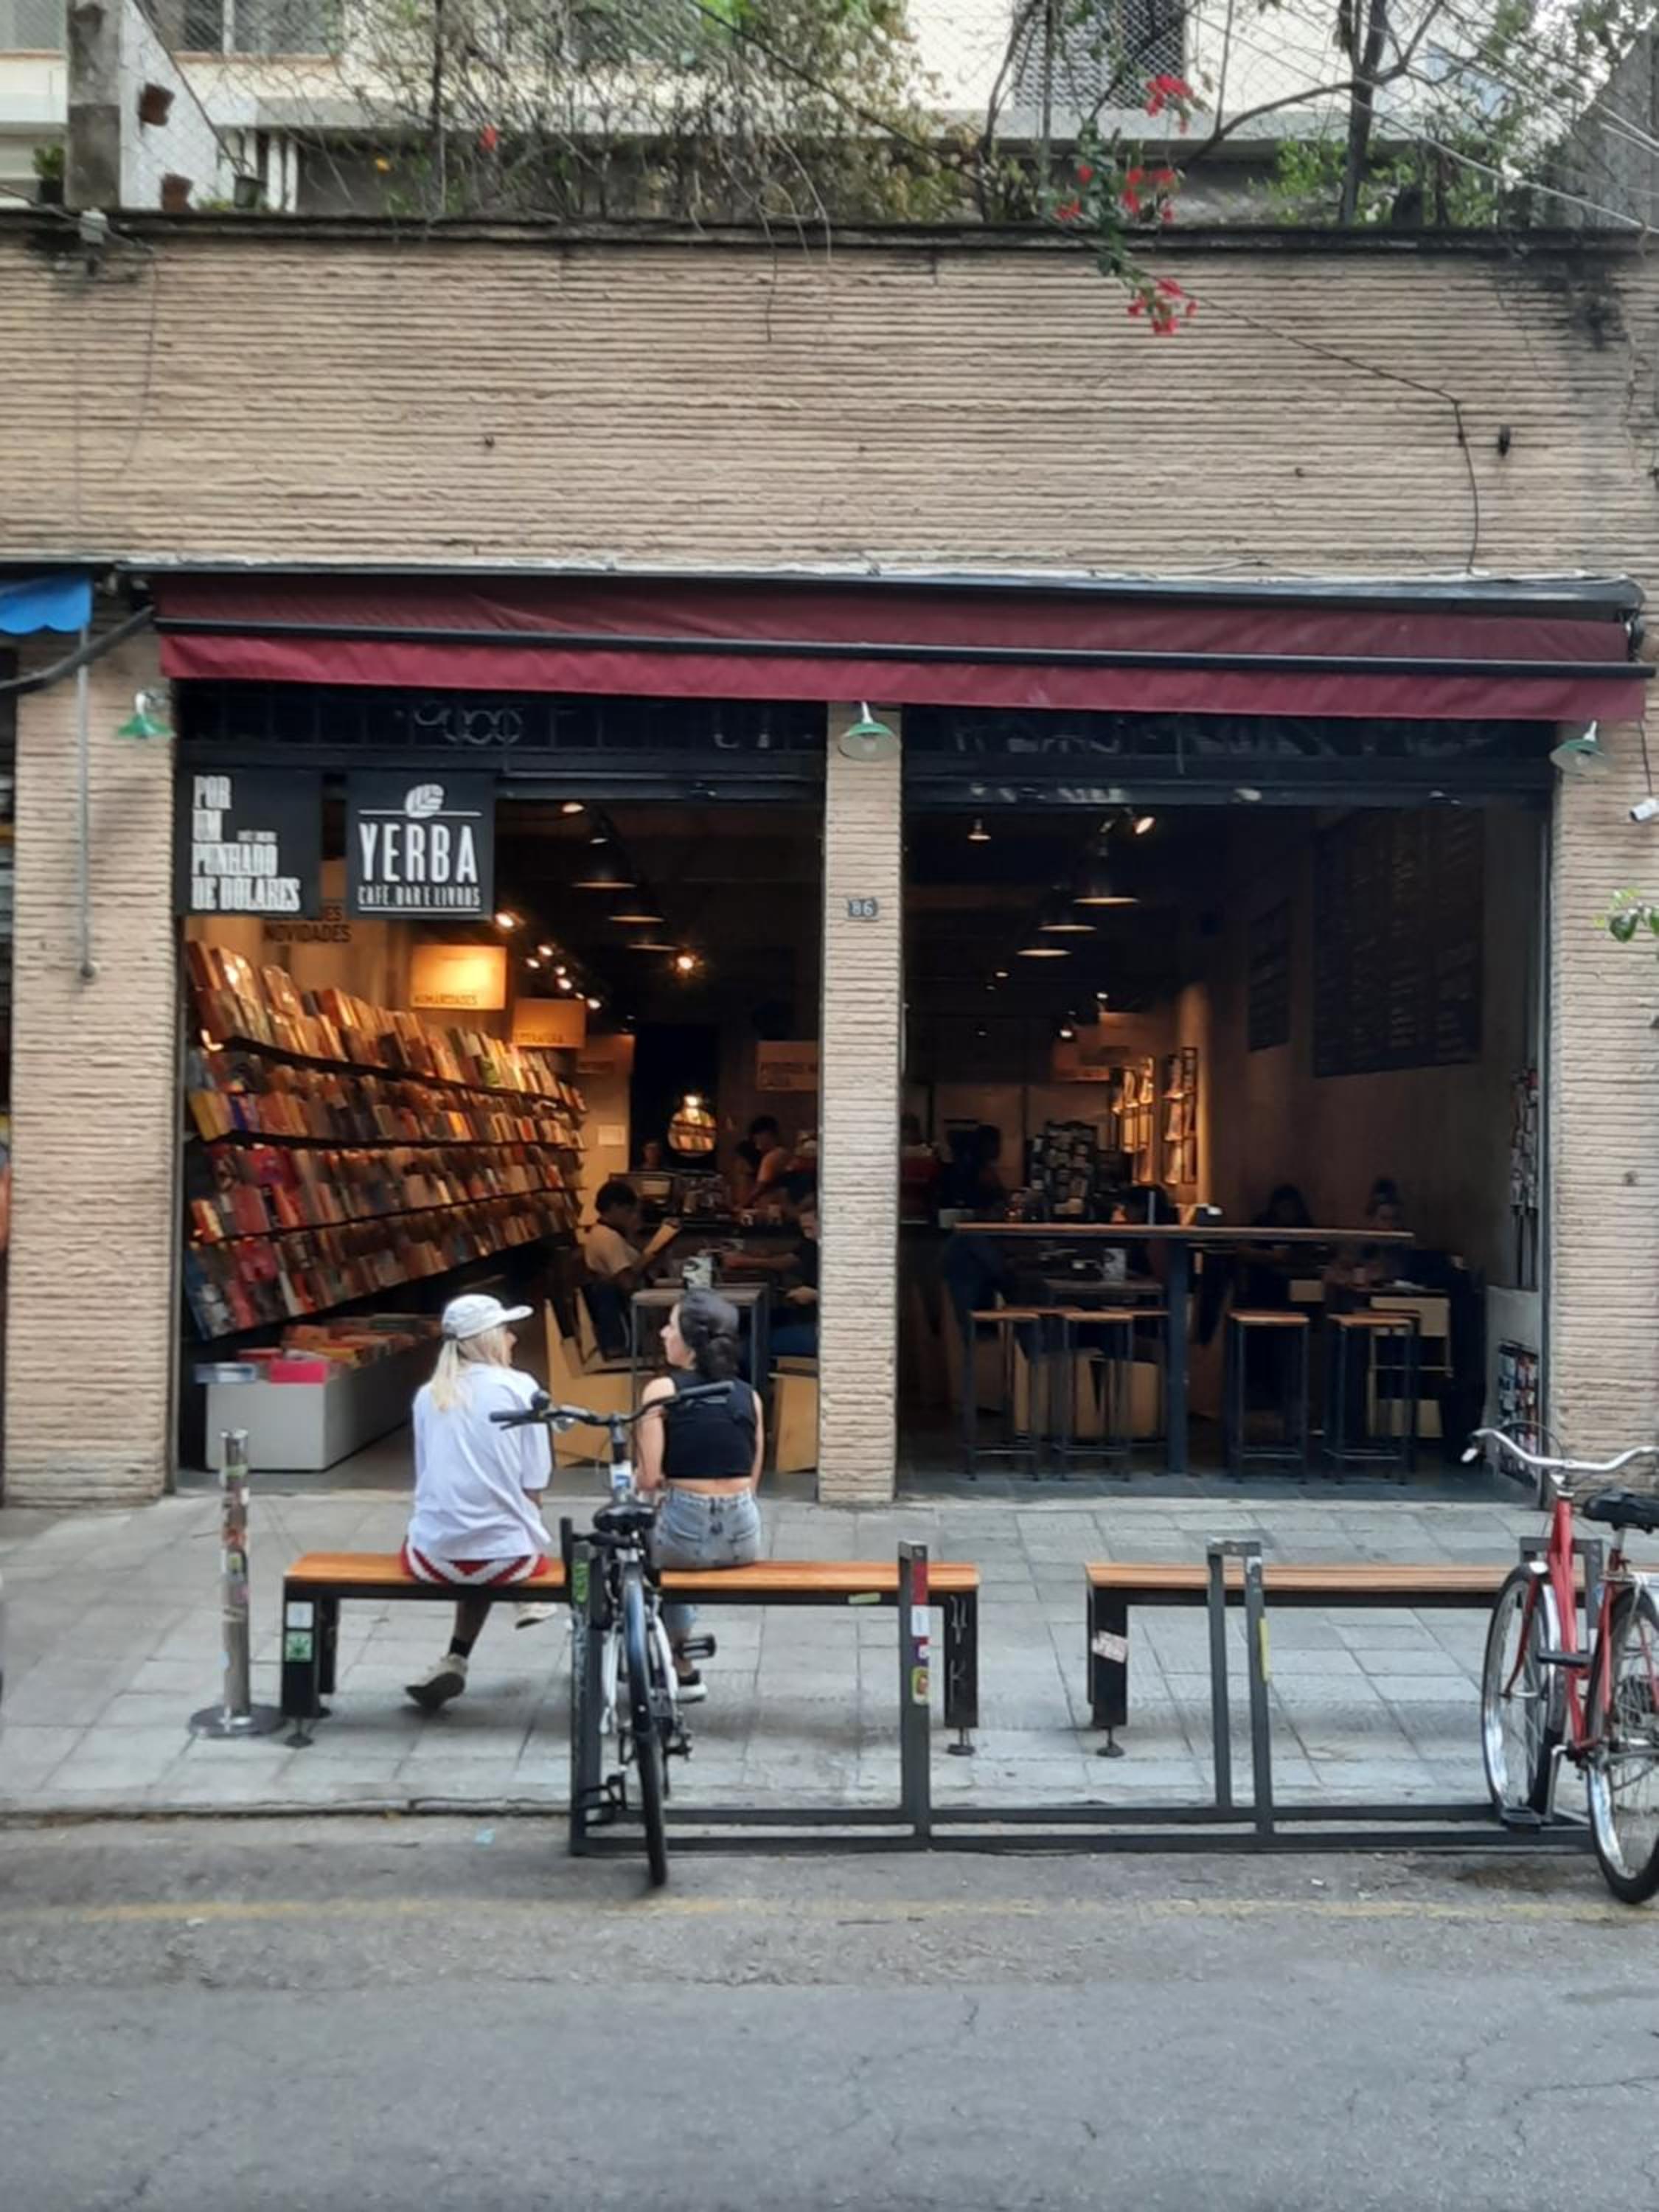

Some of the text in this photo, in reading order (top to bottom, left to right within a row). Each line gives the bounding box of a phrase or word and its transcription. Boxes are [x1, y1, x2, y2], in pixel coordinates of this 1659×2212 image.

[193, 776, 232, 810] POR
[358, 823, 478, 883] YERBA
[263, 923, 352, 943] NOVIDADES
